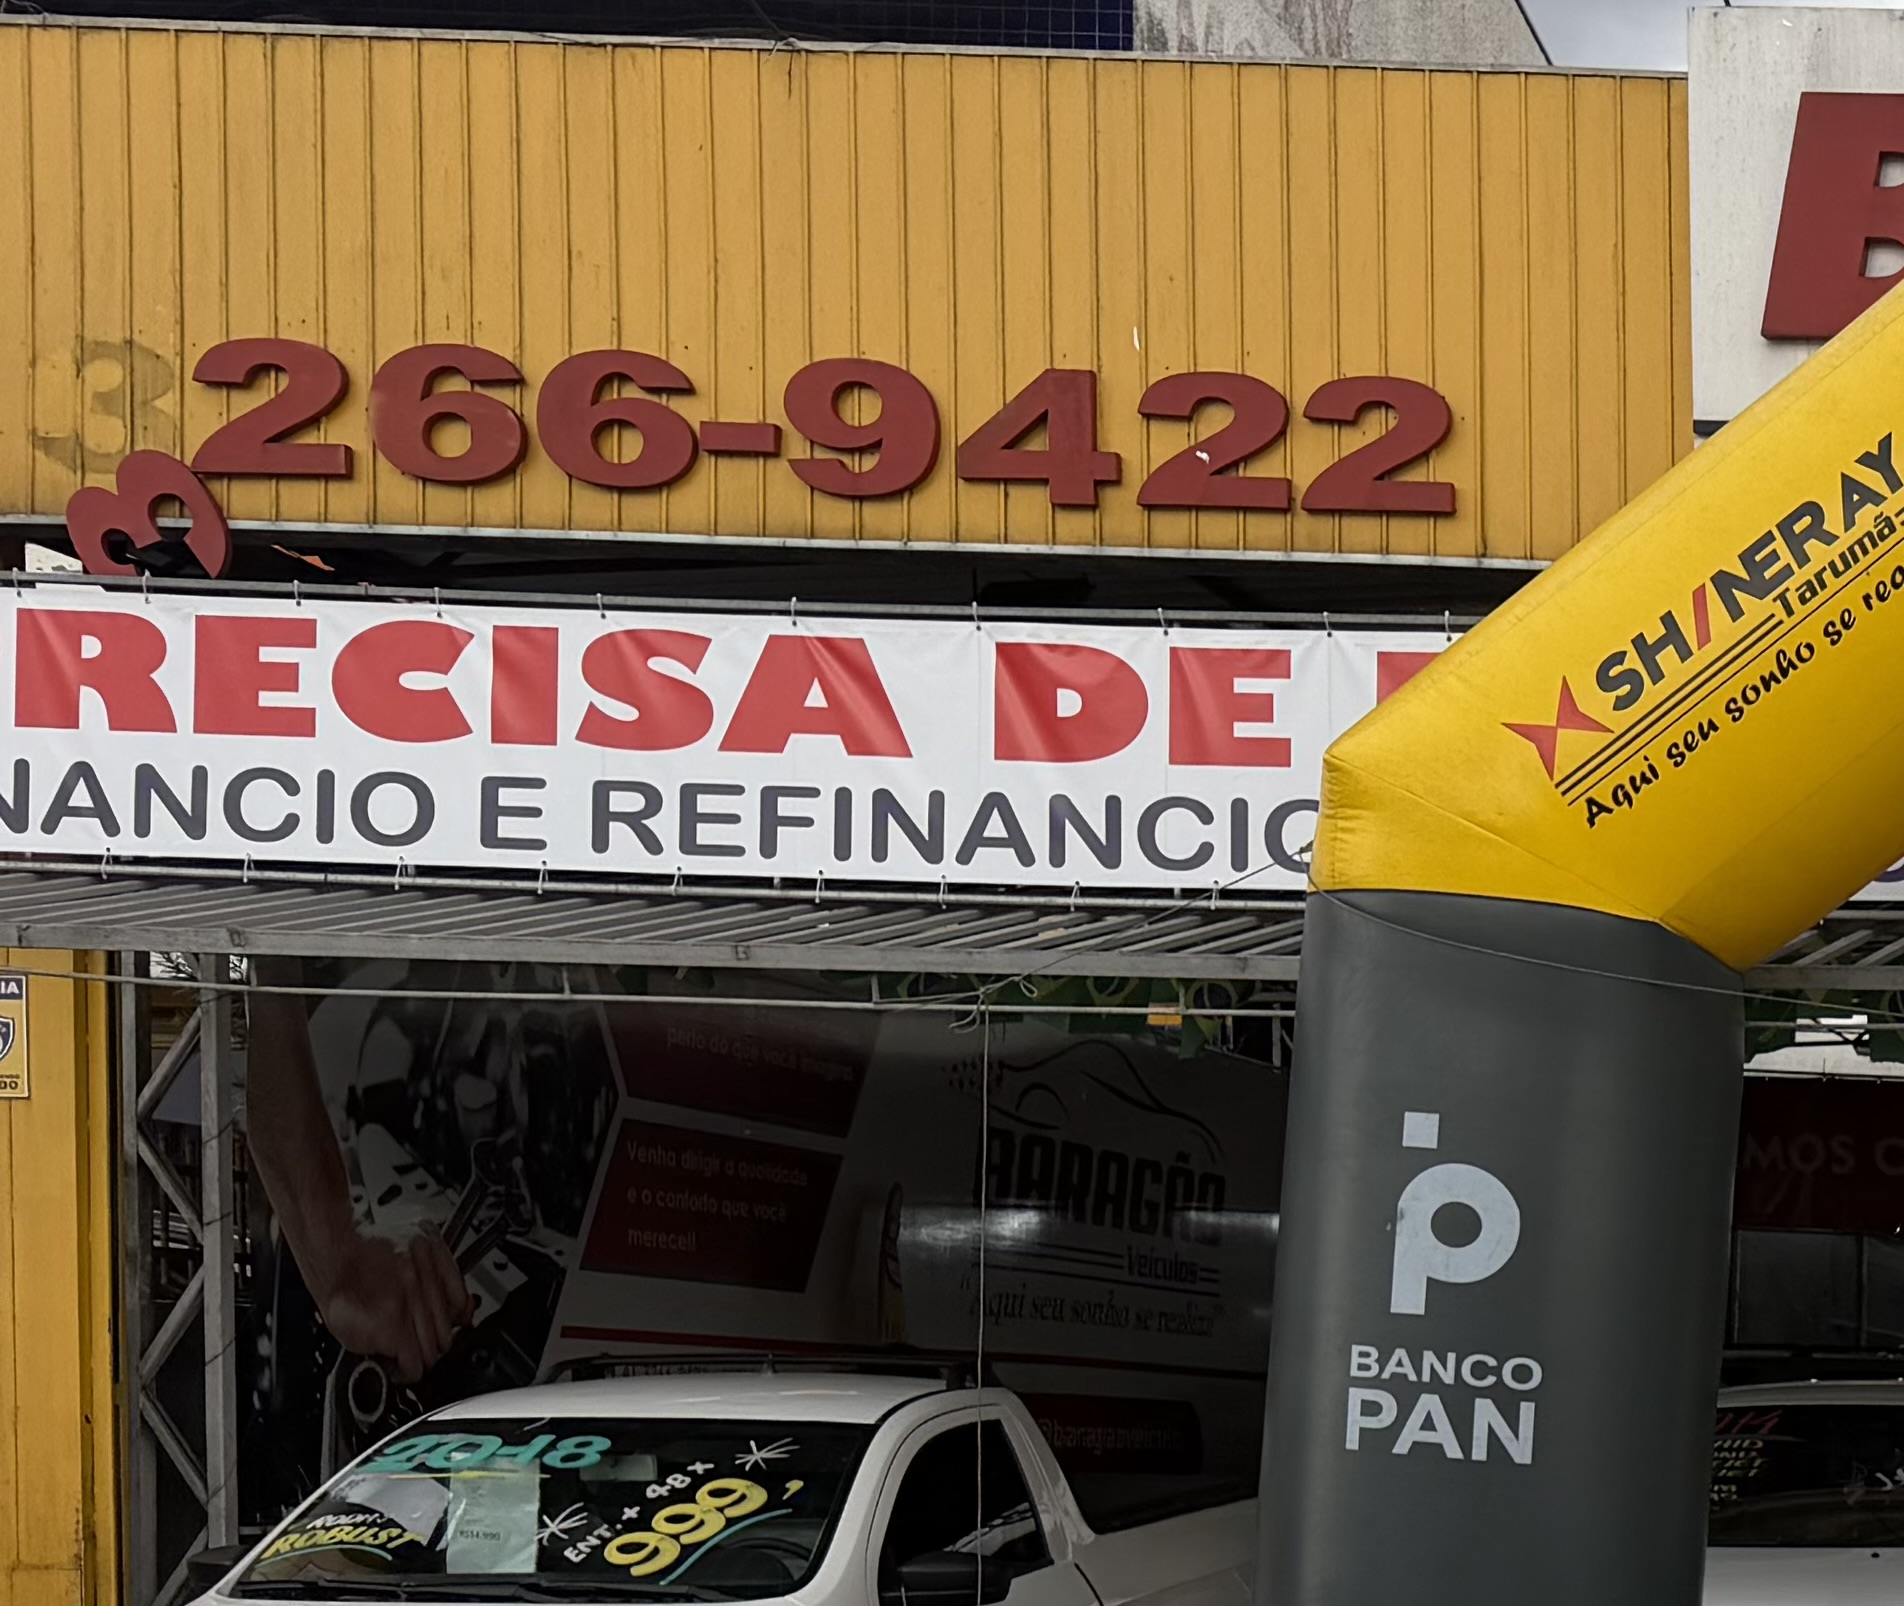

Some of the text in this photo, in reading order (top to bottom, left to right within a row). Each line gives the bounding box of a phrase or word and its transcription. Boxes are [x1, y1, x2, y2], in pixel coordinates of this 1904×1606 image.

[1595, 432, 1904, 712] SHINERAY
[1772, 511, 1897, 621] Tarumã
[13, 609, 913, 760] RECISA
[994, 642, 1292, 768] DE
[1584, 755, 1661, 829] Aqui
[1666, 717, 1721, 769] seu
[1724, 640, 1816, 724] sonho
[1823, 607, 1857, 647] se
[481, 775, 547, 852] E
[627, 1140, 676, 1168] Venha
[1349, 1344, 1543, 1391] BANCO
[354, 1433, 611, 1474] 2018
[1345, 1386, 1536, 1465] PAN
[259, 1525, 424, 1560] ROBUST
